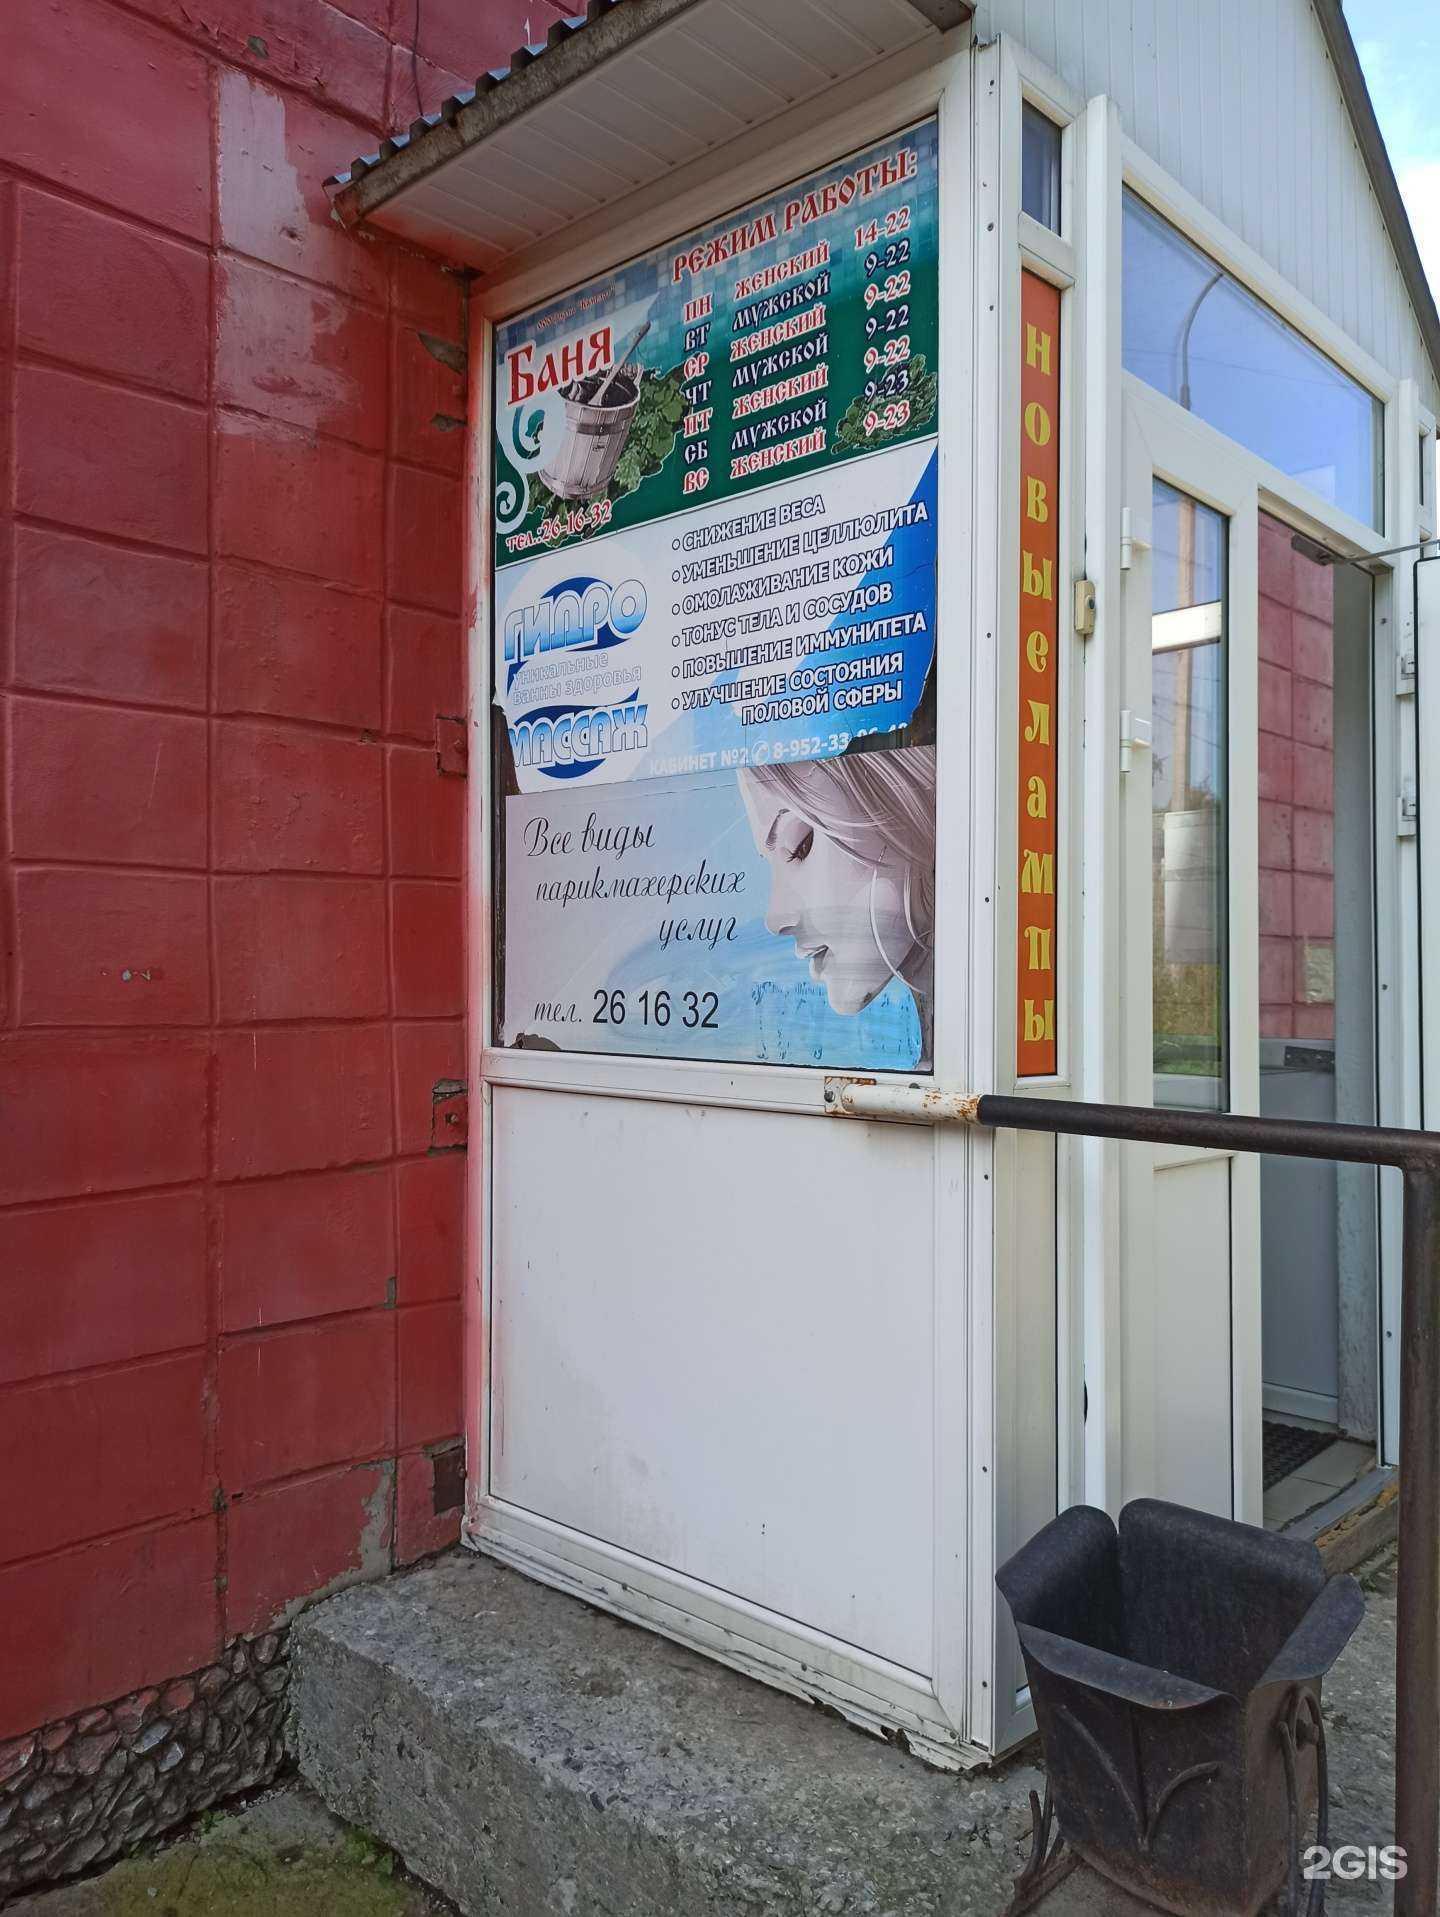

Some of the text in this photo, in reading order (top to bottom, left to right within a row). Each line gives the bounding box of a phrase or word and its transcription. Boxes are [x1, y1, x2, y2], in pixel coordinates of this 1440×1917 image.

[672, 147, 918, 283] РЕЖИМ РАБОТЫ:
[854, 205, 911, 249] 14-22
[864, 238, 910, 278] 9-22
[864, 270, 911, 310] 9-22
[865, 305, 909, 339] 9-22
[863, 334, 910, 373] 9-22
[864, 369, 909, 403] 9-23
[863, 399, 910, 436] 9-23
[682, 495, 825, 552] СНИЖЕНИЕ ВЕСА
[682, 502, 928, 583] УМЕНЬШЕНИЕ ЦЕЛЛЮЛИТА
[682, 546, 893, 615] ОМОЛАЖИВАНИЕ КОЖИ
[504, 577, 648, 662] ГИДРО
[682, 583, 892, 647] ТОНУС ТЕЛА И СОСУДОВ
[682, 612, 927, 679] ПОВЫШЕНИЕ ИММУНИТЕТА
[565, 665, 642, 695] здоровья
[682, 652, 903, 711] УЛУЧШЕНИЕ СОСТОЯНИЯ
[742, 680, 902, 726] ПОЛОВОЙ СФЕРЫ
[650, 751, 717, 775] КАБИНЕТ
[523, 812, 656, 860] Все виды
[536, 859, 746, 908] парикмахерских
[659, 917, 738, 950] услуг
[534, 1002, 582, 1023] тел.
[592, 989, 626, 1025] 26
[638, 990, 671, 1026] 16
[682, 991, 719, 1028] 32
